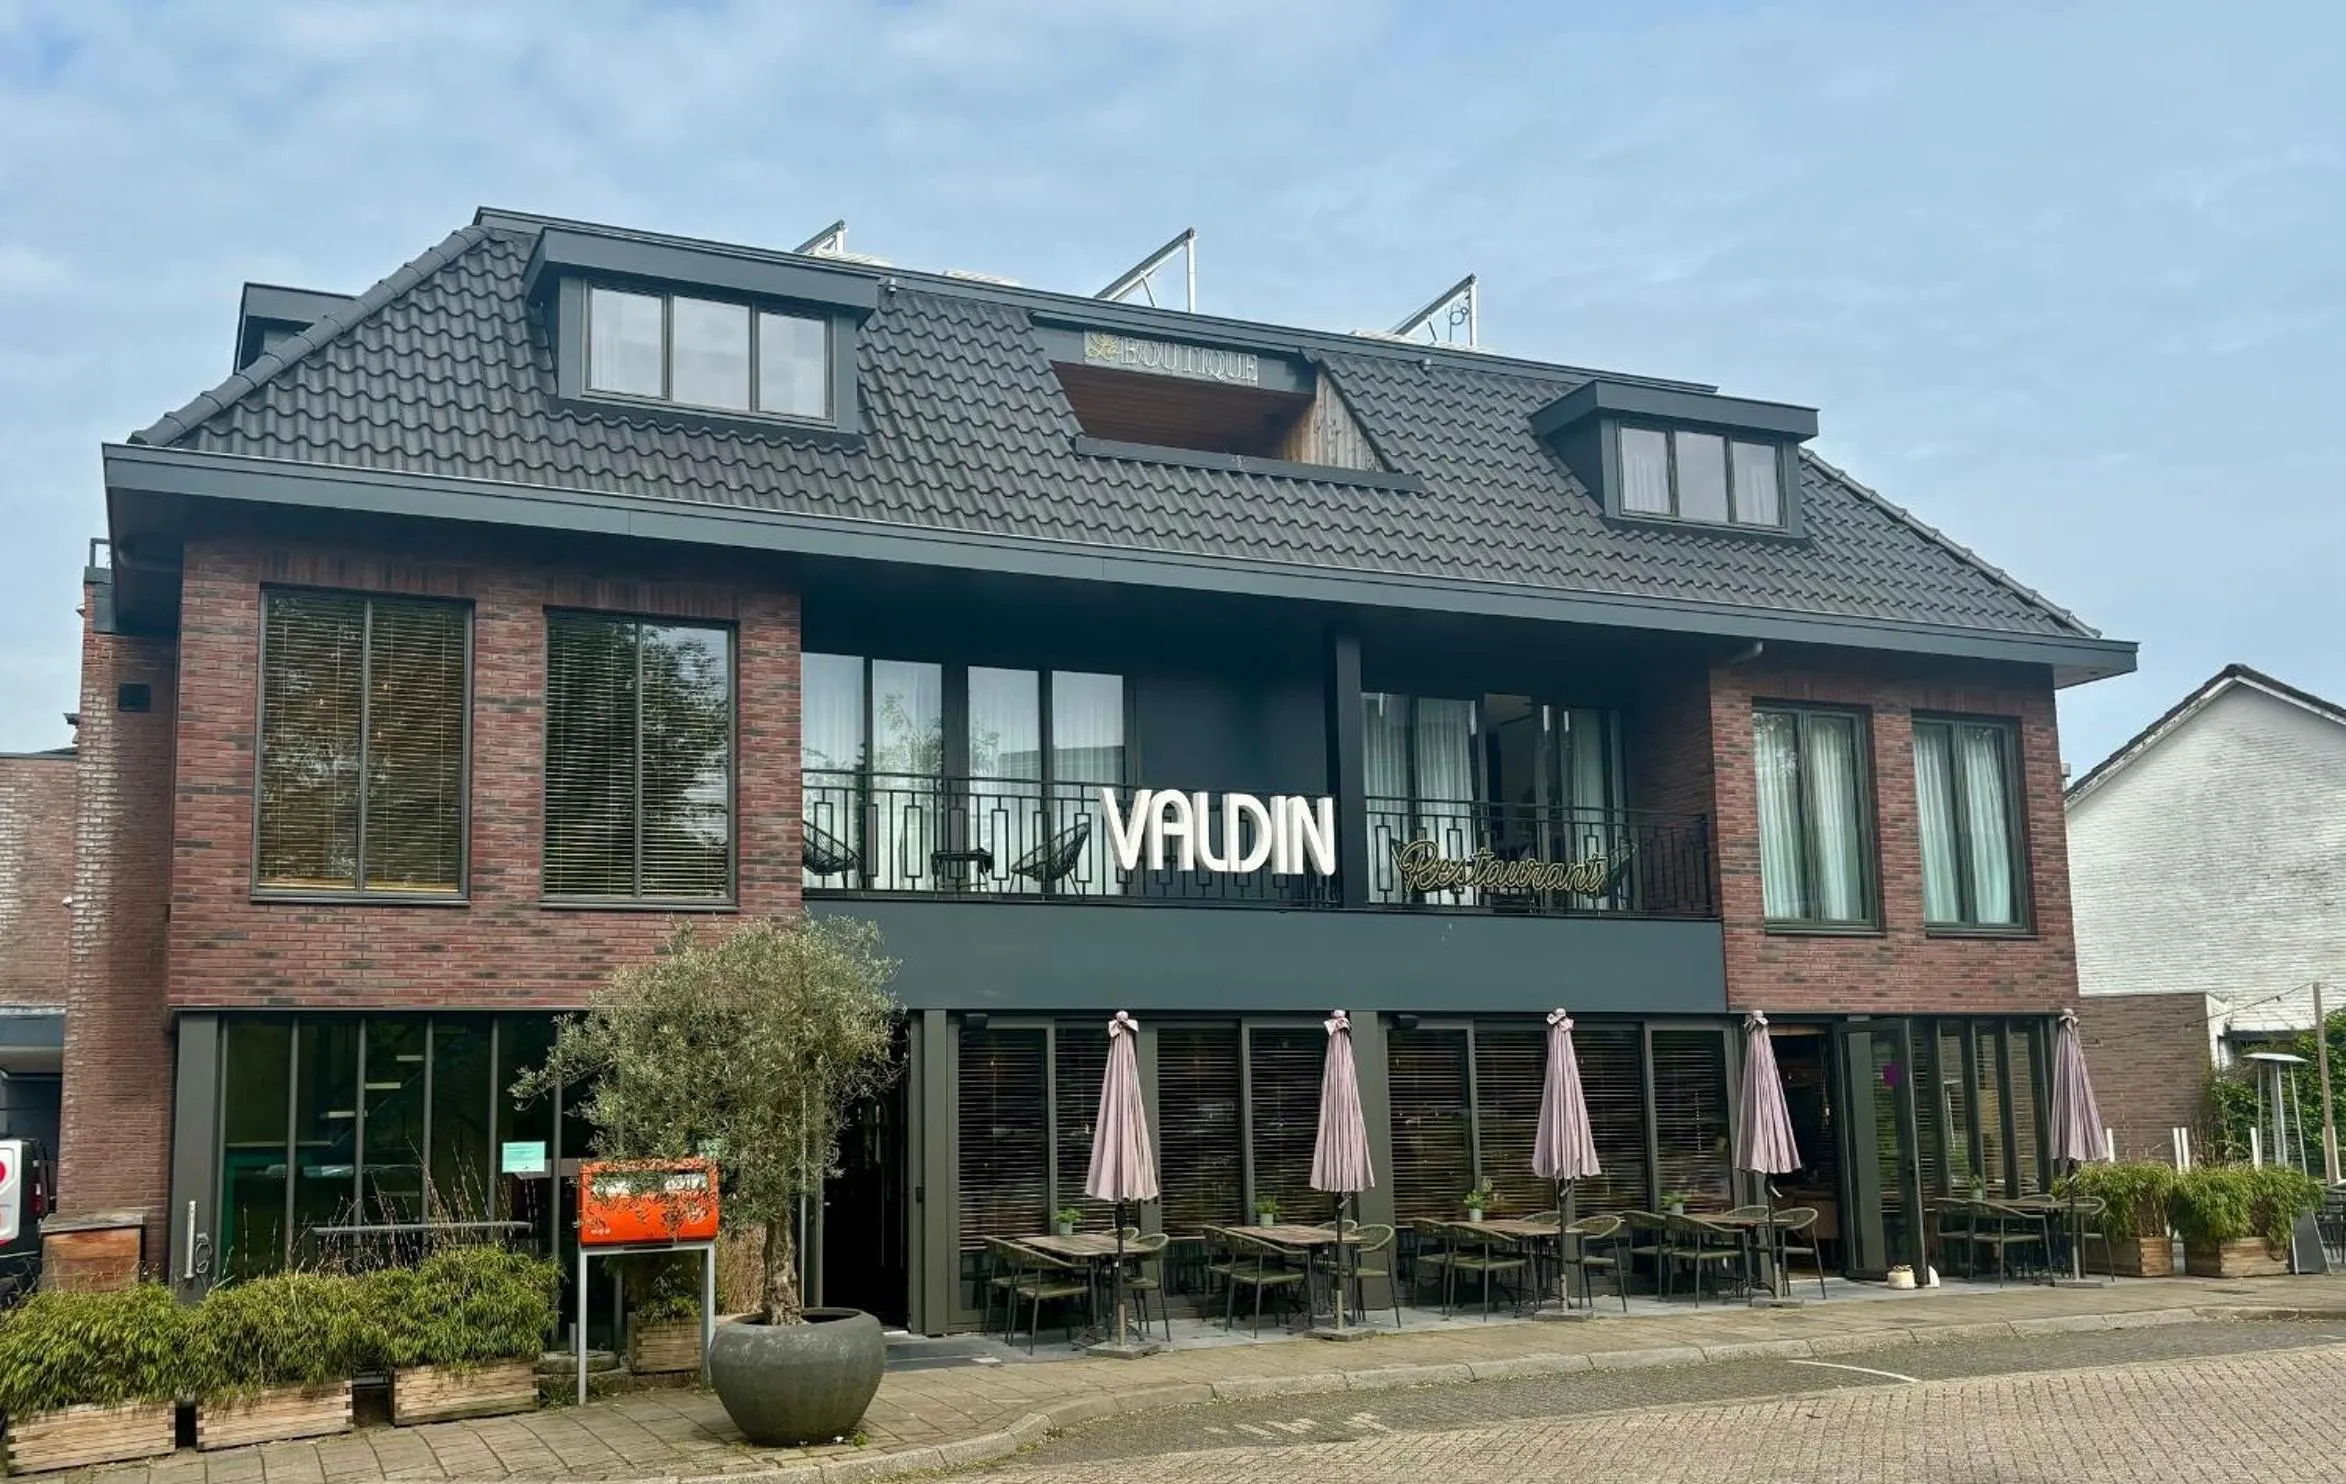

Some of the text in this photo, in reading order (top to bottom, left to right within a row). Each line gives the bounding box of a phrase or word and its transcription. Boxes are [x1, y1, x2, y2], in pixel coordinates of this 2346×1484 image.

[1120, 336, 1258, 382] BOUTIQUE
[1101, 787, 1336, 876] VALDIN
[1400, 839, 1608, 892] Restaurant
